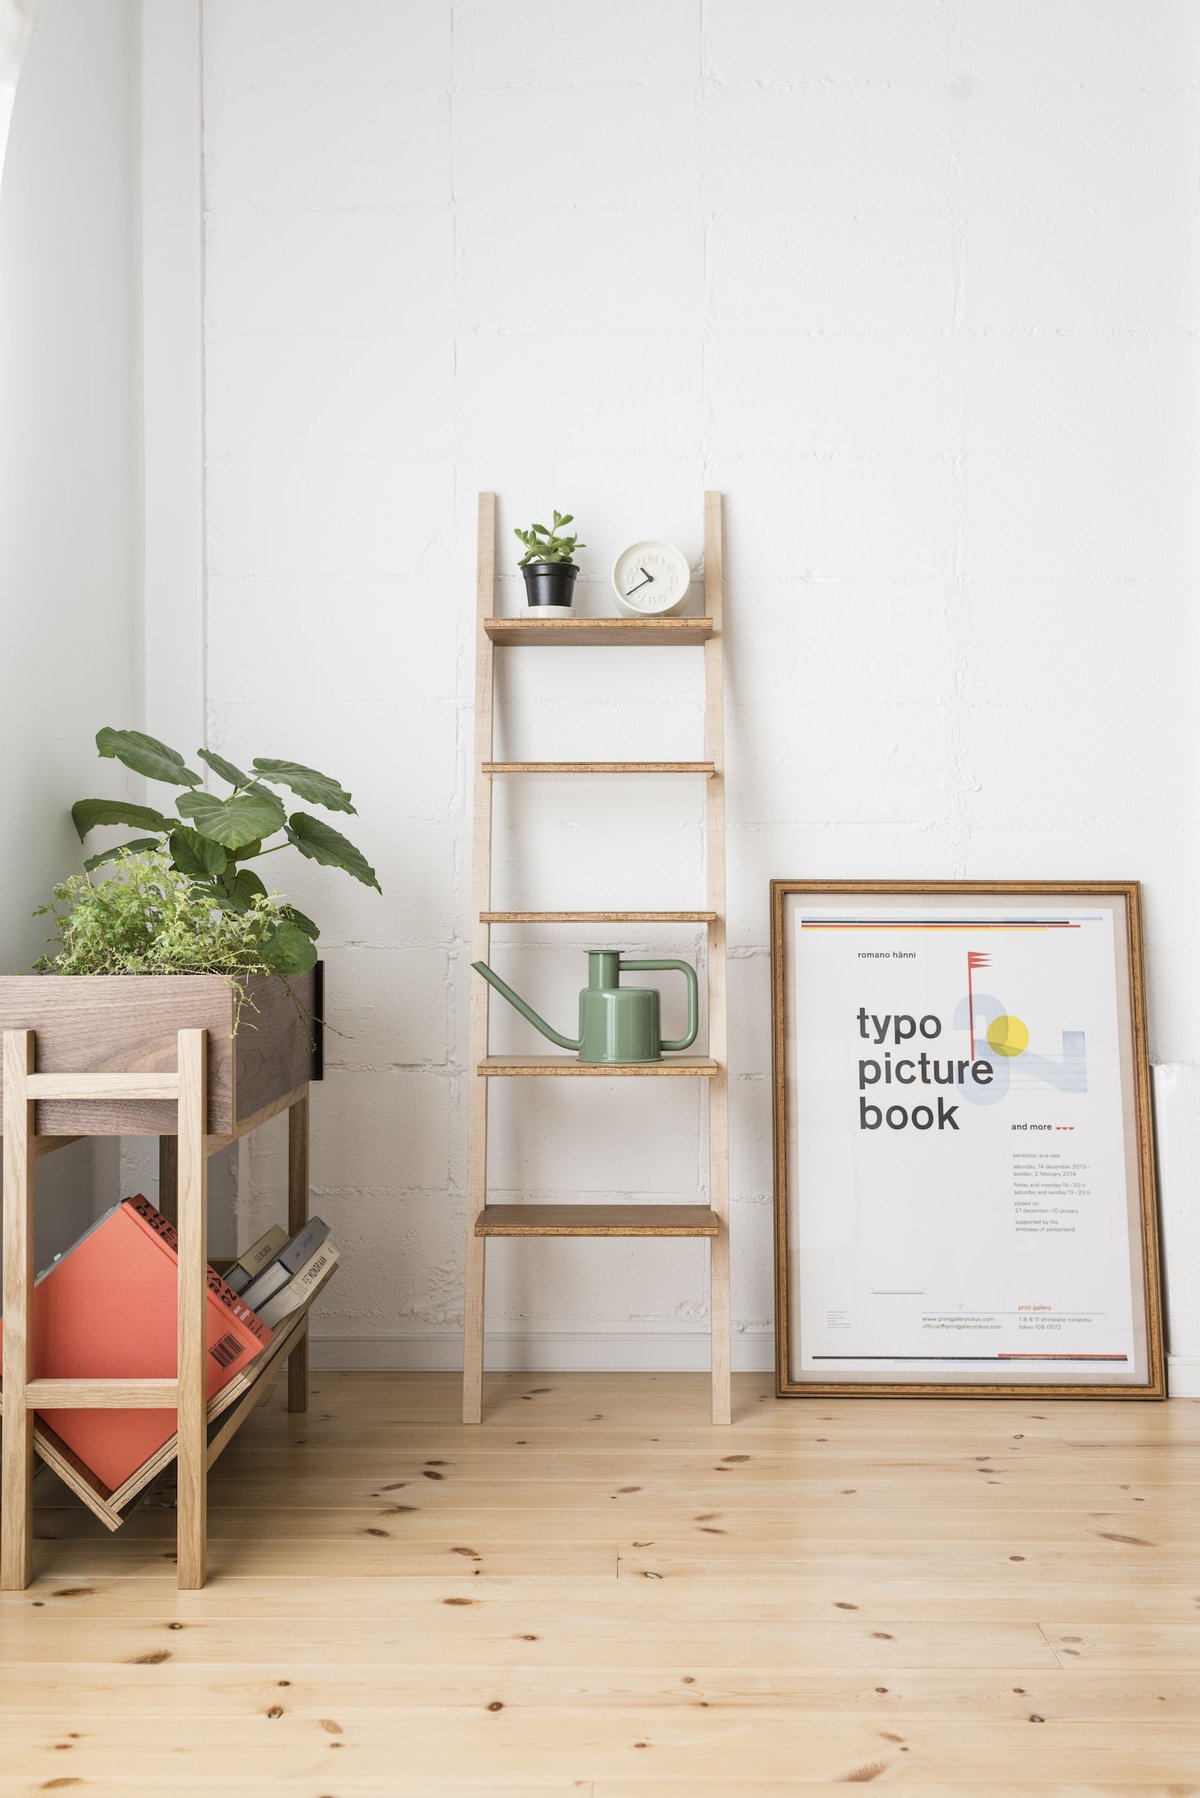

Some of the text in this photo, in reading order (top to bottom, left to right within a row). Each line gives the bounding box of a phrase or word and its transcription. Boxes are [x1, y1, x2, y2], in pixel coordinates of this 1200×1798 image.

[892, 951, 916, 959] hänni
[857, 1007, 942, 1044] typo
[858, 1052, 994, 1090] picture
[860, 1096, 960, 1130] book
